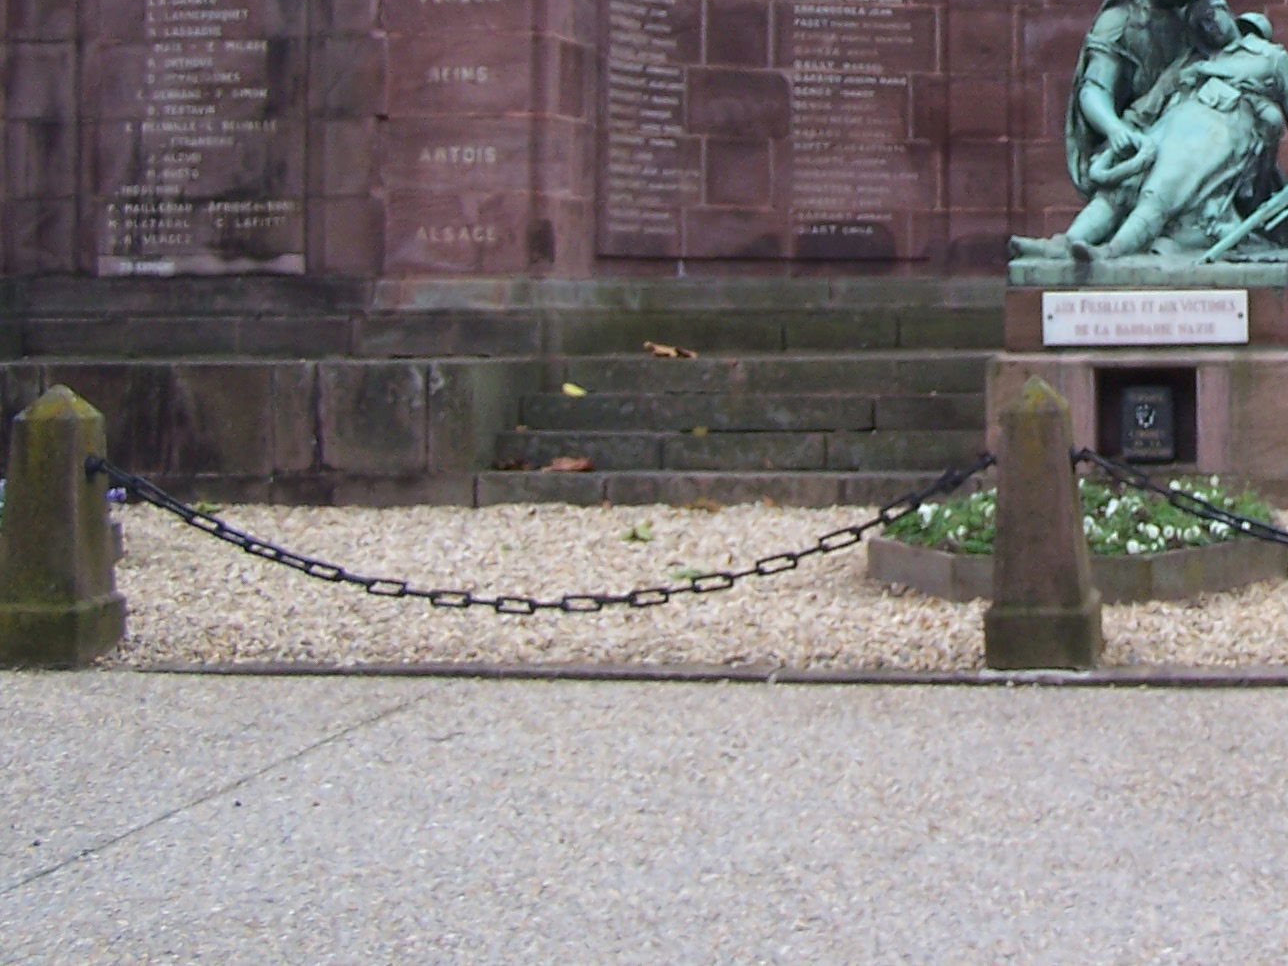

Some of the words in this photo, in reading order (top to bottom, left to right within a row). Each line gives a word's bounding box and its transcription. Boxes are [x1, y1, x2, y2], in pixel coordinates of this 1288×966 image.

[427, 65, 489, 84] REIMS
[418, 145, 497, 164] ARTOIS
[416, 225, 497, 243] ALSACE
